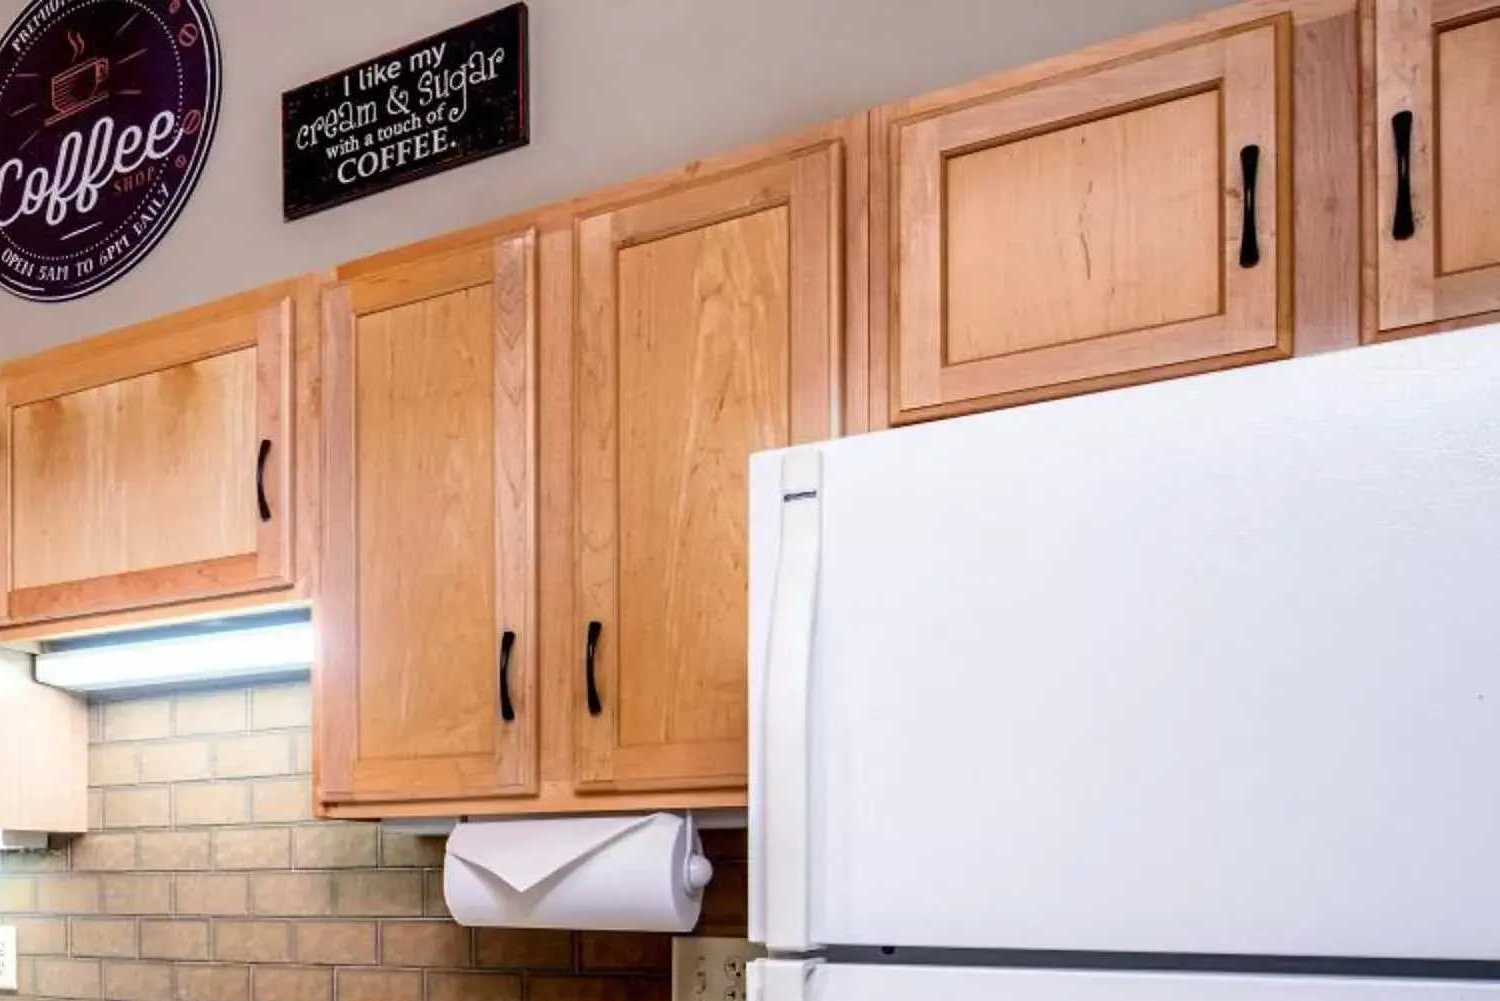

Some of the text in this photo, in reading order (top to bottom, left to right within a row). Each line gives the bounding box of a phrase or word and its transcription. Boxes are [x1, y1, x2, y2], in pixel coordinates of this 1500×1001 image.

[12, 0, 71, 52] PREMIU
[344, 41, 447, 96] I like my
[296, 46, 506, 150] cream & Sugar
[325, 101, 447, 160] with a touch of
[337, 126, 457, 184] COFFEE.
[112, 166, 156, 196] SHOP
[1, 181, 171, 282] OPEN 5AM TO 6PM DAILY
